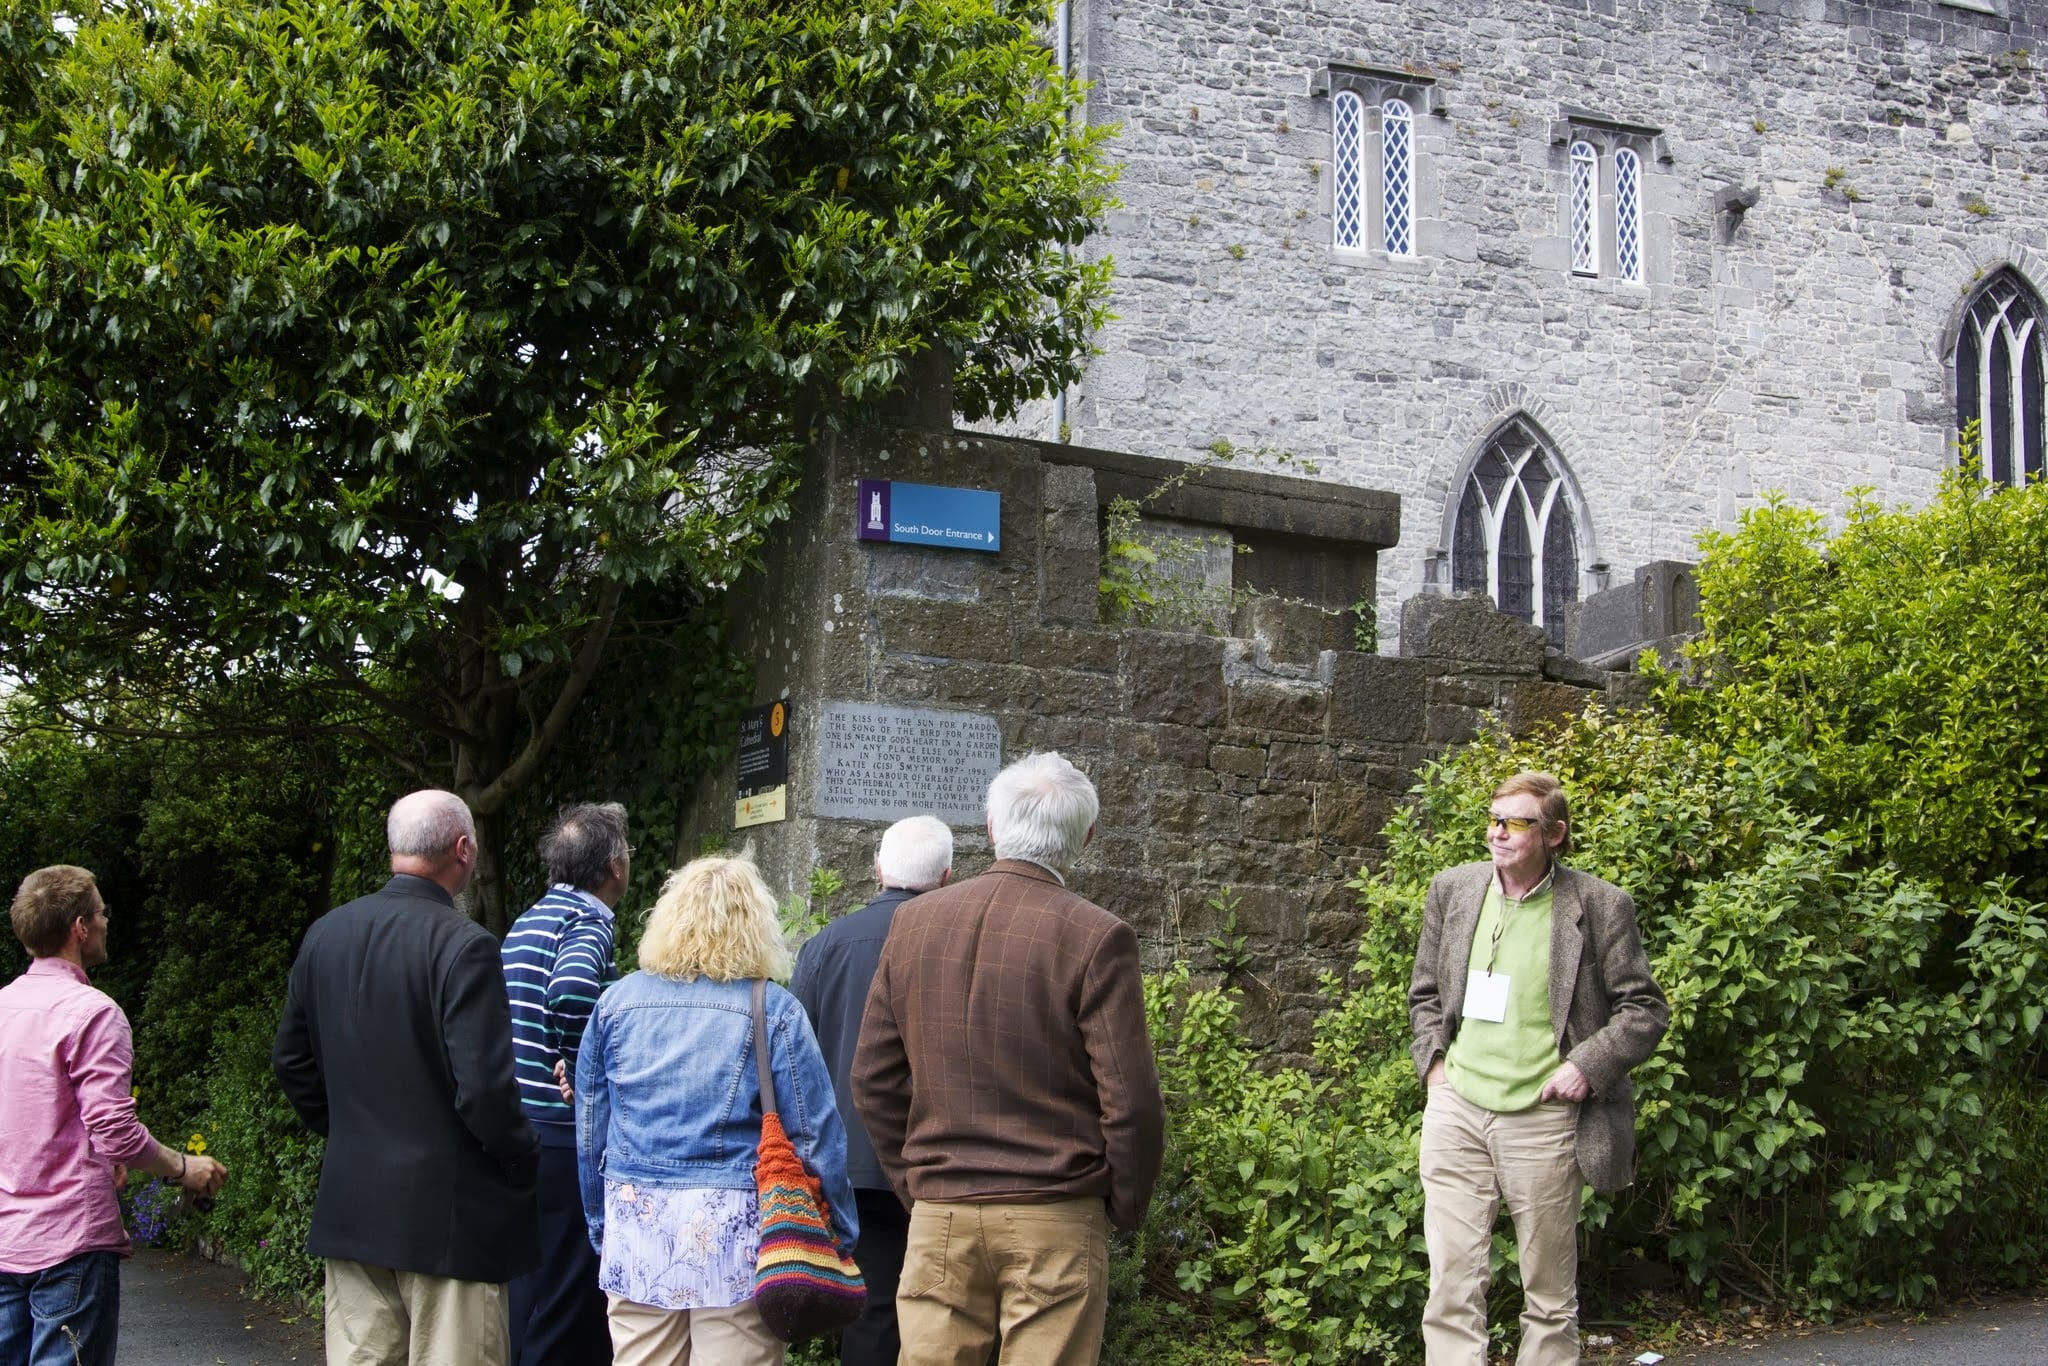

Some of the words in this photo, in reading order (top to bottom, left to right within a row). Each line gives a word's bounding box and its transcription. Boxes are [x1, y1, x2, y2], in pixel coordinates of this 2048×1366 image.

[894, 523, 919, 534] South
[921, 526, 944, 536] Door
[946, 528, 983, 540] Entrance
[830, 713, 845, 721] THE
[853, 715, 872, 723] KISS
[896, 718, 911, 726] THE
[918, 719, 933, 727] SUN
[962, 722, 997, 731] PARDON
[830, 723, 845, 731] THE
[852, 724, 875, 732] SONG
[881, 726, 890, 734] OF
[920, 729, 940, 737] BIRD
[946, 730, 962, 738] FOR
[969, 732, 997, 741] MIRTH
[826, 732, 841, 740] ONE
[855, 734, 886, 742] NEARER
[890, 736, 910, 744] GOD'S
[913, 738, 938, 746] HEART
[967, 741, 998, 750] GARDEN
[831, 741, 855, 750] THAN
[889, 745, 916, 754] PLACE
[922, 747, 941, 756] ELSE
[966, 750, 995, 759] EARTH
[873, 762, 892, 770] (CIS)
[878, 753, 900, 762] FOND
[908, 755, 946, 764] MEMORY
[956, 758, 965, 766] OF
[826, 768, 846, 777] WHO
[873, 772, 908, 780] LABOUR
[925, 775, 954, 783] GREAT
[826, 777, 843, 785] THIS
[847, 778, 893, 788] CATHEDRAL
[915, 782, 932, 790] THE
[828, 786, 853, 795] STILL
[863, 788, 897, 796] TENDED
[906, 791, 926, 799] THIS
[934, 793, 969, 801] FLOWER
[824, 796, 854, 804] HAVING
[858, 798, 877, 806] DONE
[912, 801, 934, 809] MORE
[938, 802, 958, 810] THAN
